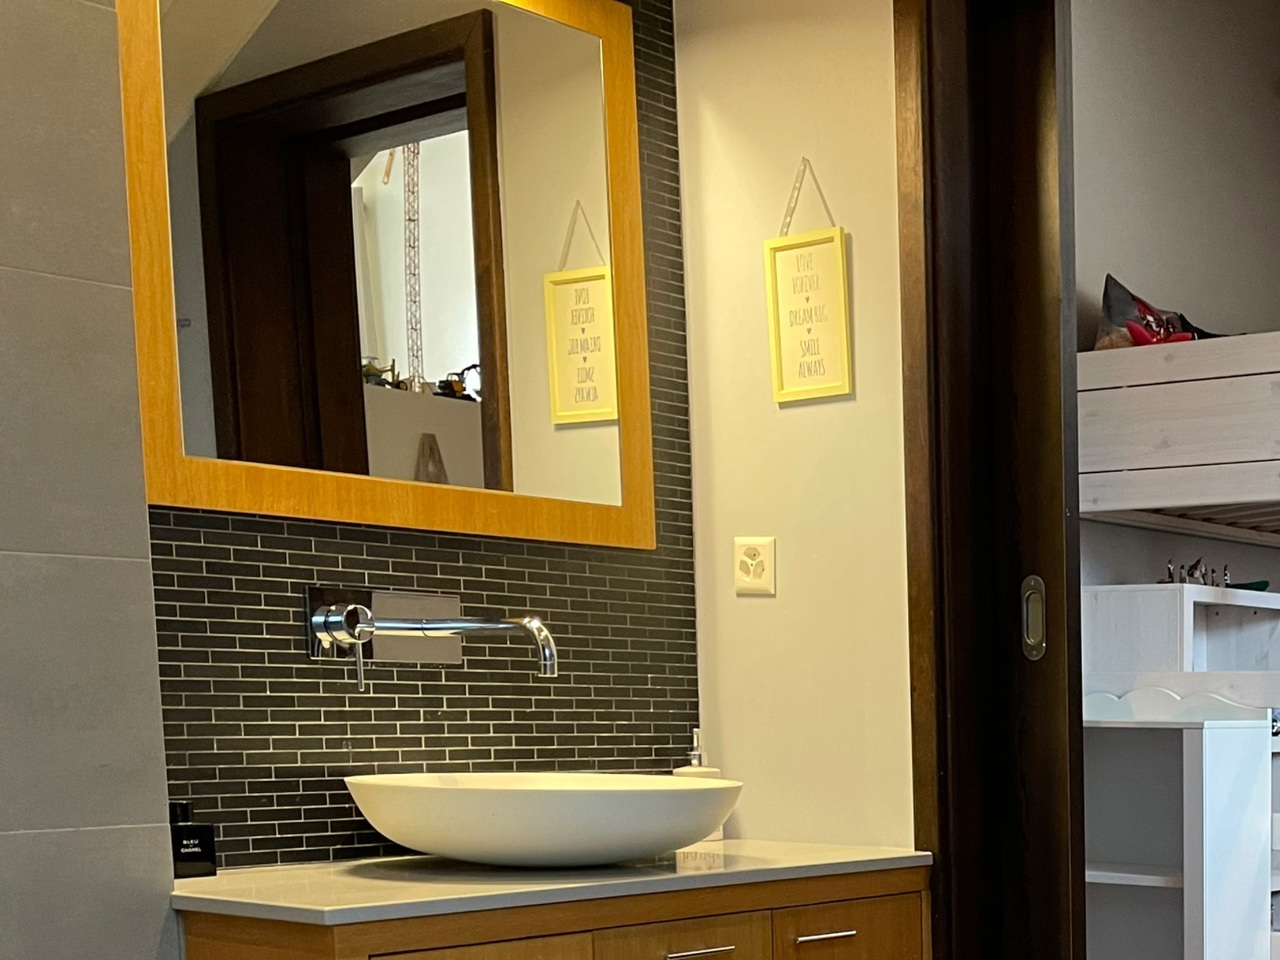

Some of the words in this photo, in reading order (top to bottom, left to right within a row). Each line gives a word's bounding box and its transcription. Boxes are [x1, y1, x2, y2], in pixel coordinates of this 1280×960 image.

[796, 253, 814, 272] LOVE
[792, 274, 820, 294] FOREVER
[789, 306, 813, 327] DREAM
[800, 338, 820, 358] SMILE
[798, 358, 825, 378] ALWAYS
